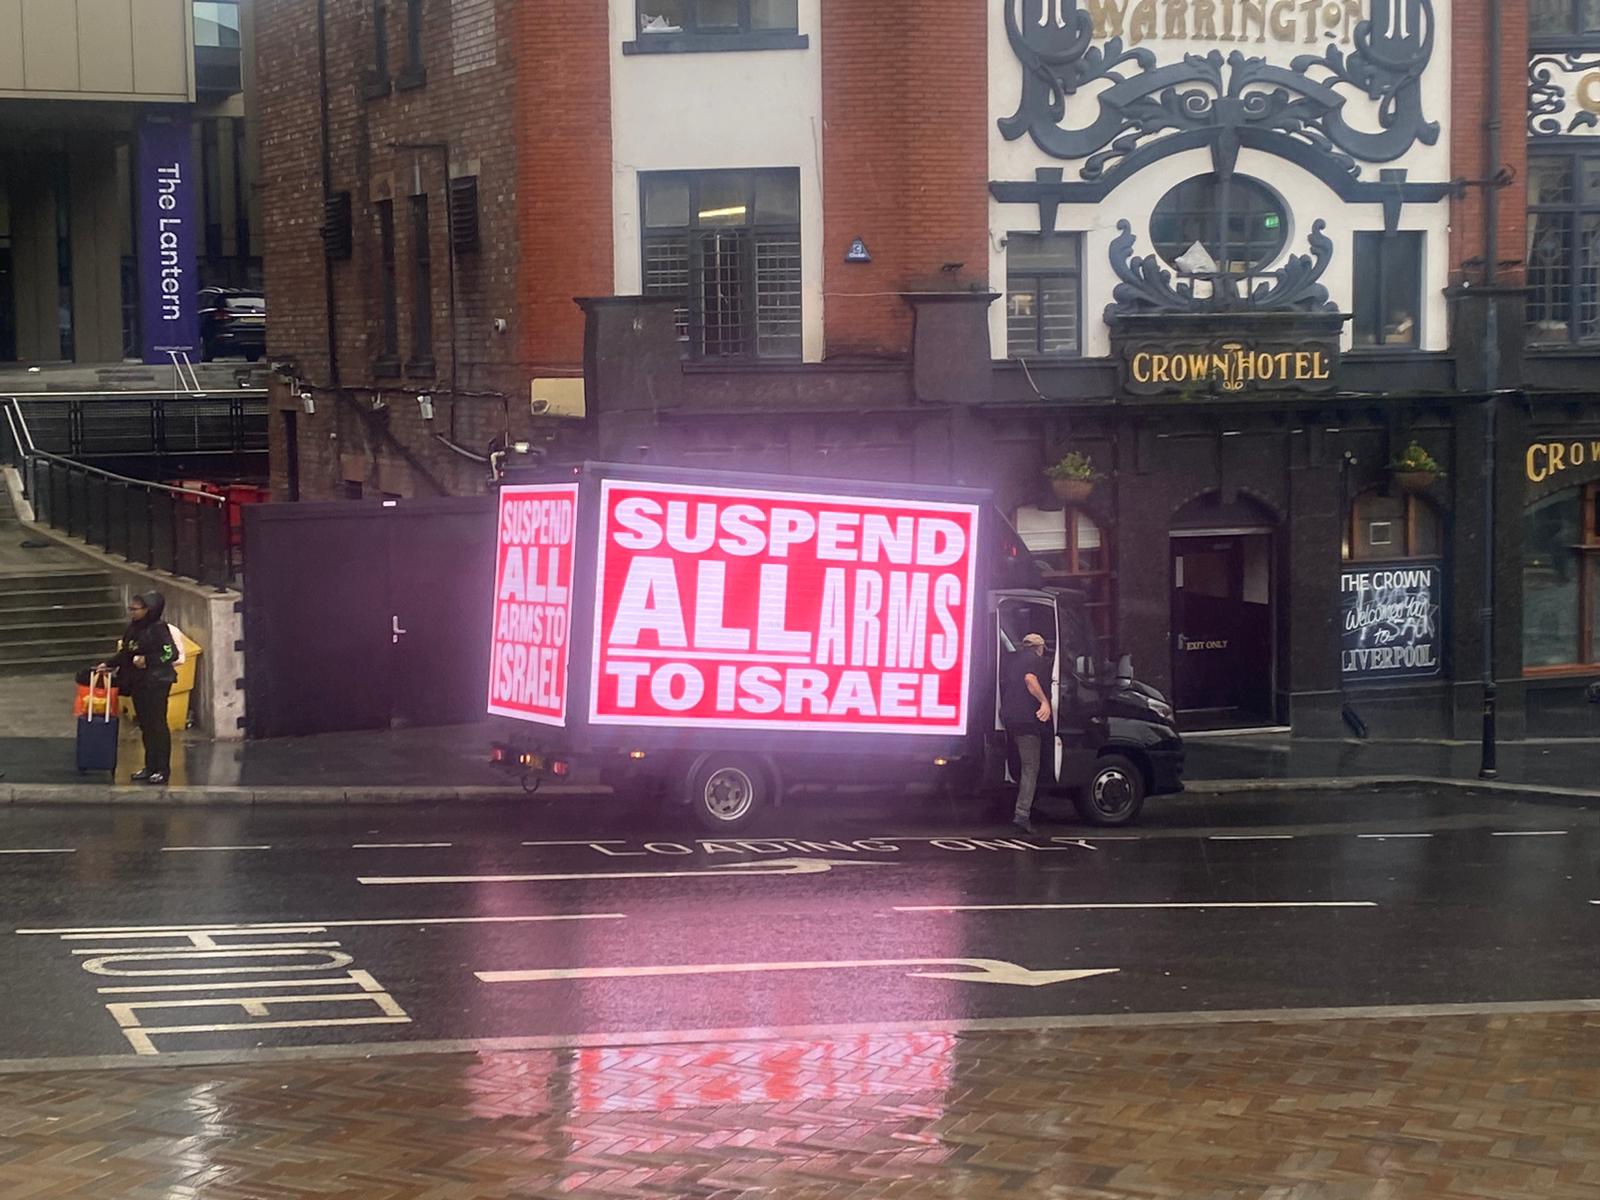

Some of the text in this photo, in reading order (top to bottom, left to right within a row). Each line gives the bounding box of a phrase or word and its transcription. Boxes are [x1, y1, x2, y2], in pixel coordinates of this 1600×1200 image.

[1089, 0, 1362, 43] WARRINGTON
[157, 163, 182, 210] The
[158, 218, 184, 320] Lantern
[1132, 350, 1330, 383] CROWN HOTEL
[502, 498, 572, 545] SUSPEND
[612, 496, 966, 567] SUSPEND
[498, 546, 567, 602] ALL
[1341, 570, 1431, 592] THE CROWN
[496, 604, 566, 648] ARMS TO
[608, 556, 962, 671] ALL ARMS
[1186, 639, 1228, 651] EXIT ONLY
[1341, 646, 1436, 672] LIVERPOOL
[492, 642, 561, 709] ISRAEL
[605, 660, 956, 719] TO ISRAEL
[589, 836, 1098, 857] LOADING ONLY
[59, 925, 412, 1056] HOTEL
